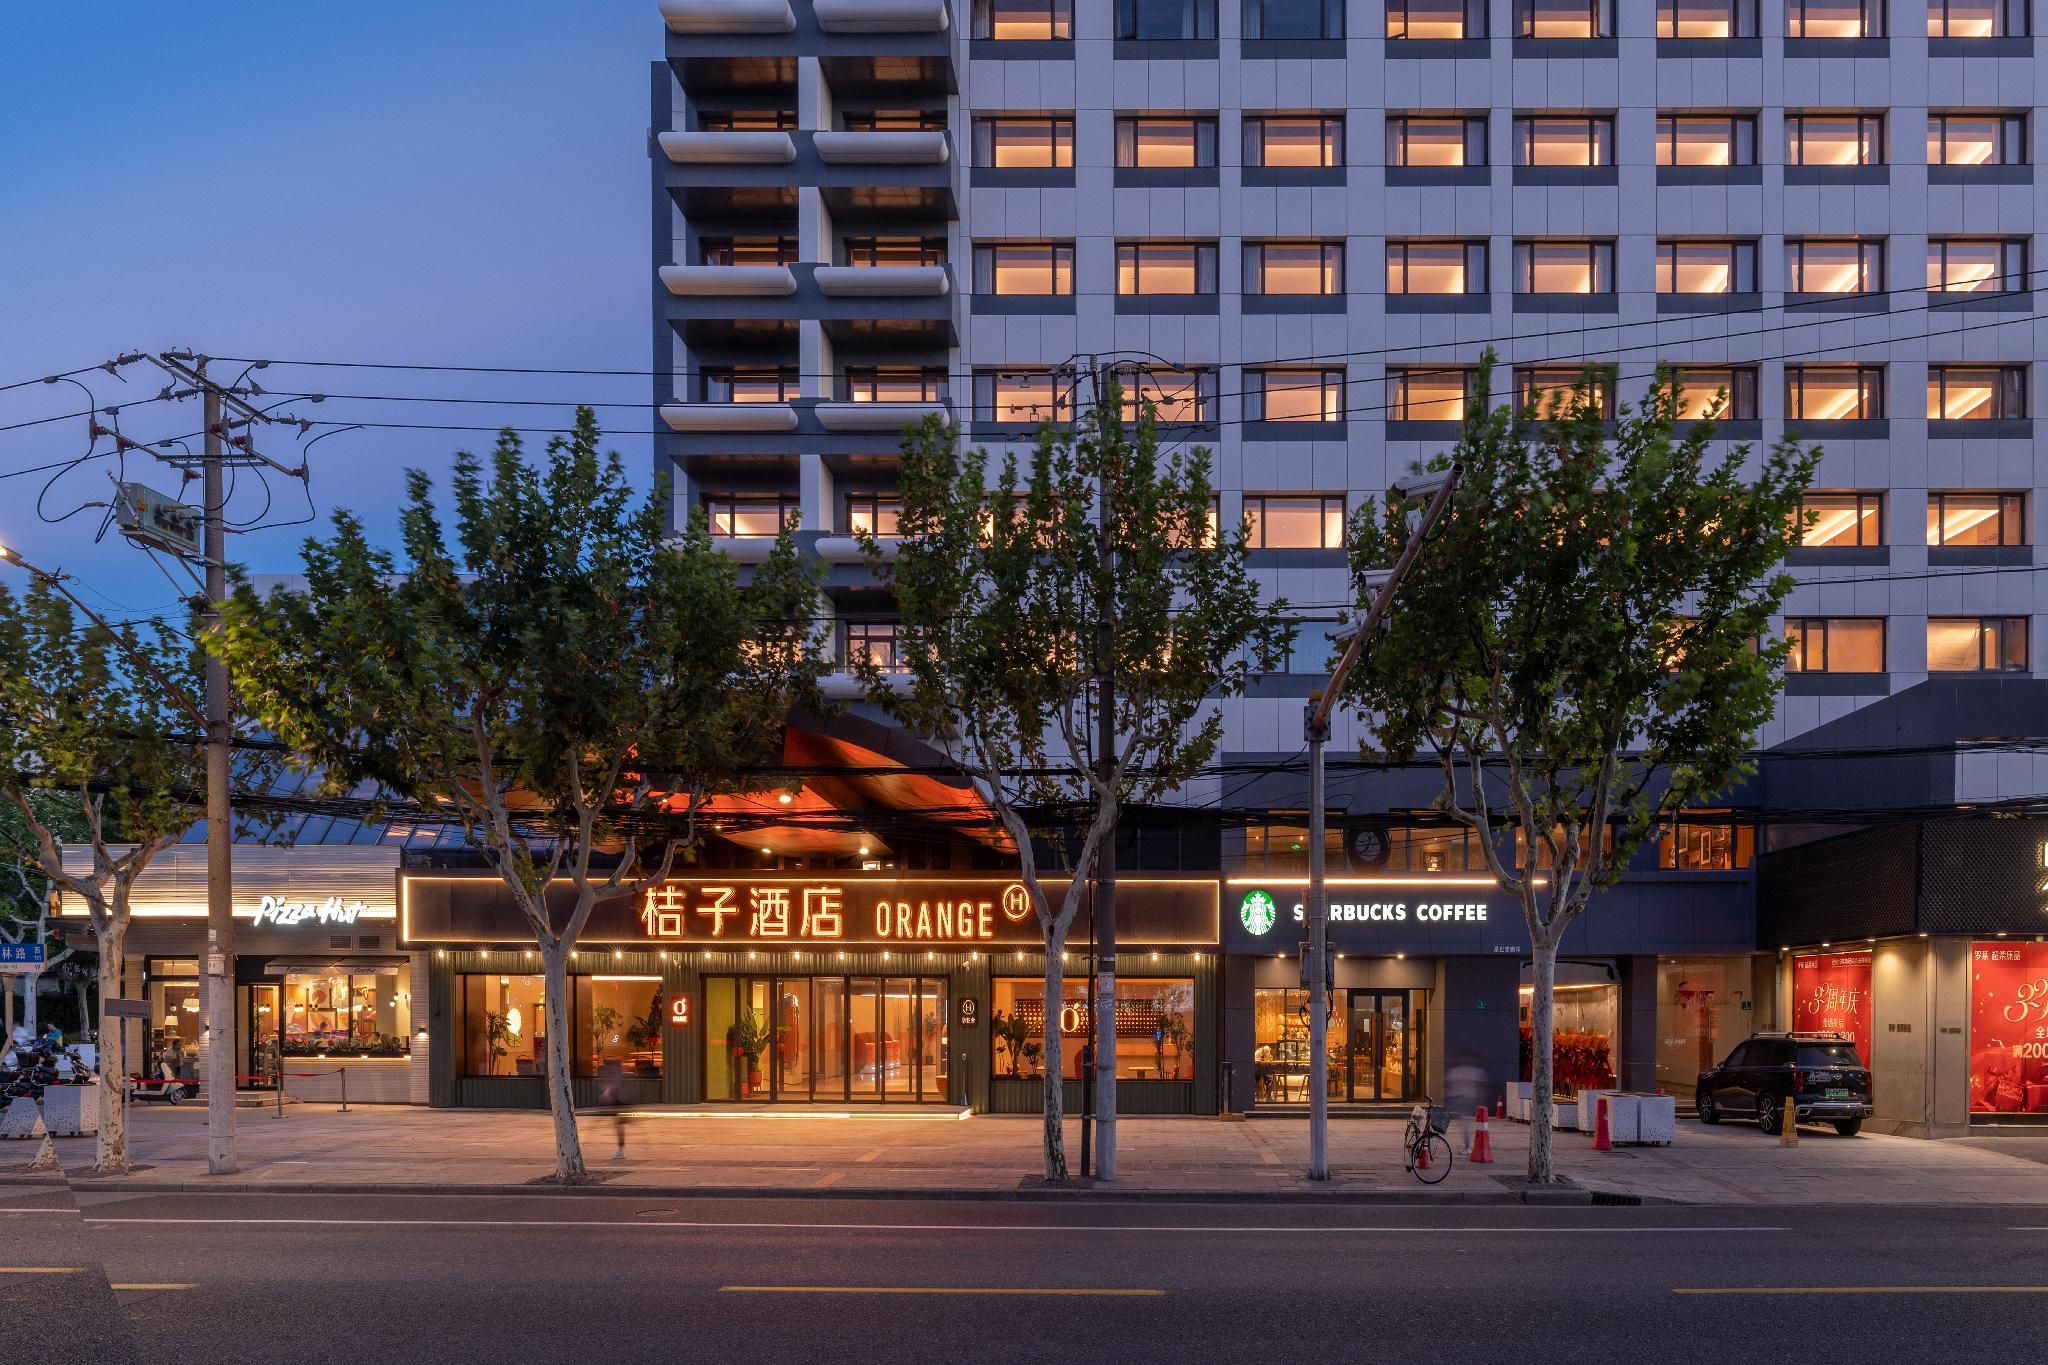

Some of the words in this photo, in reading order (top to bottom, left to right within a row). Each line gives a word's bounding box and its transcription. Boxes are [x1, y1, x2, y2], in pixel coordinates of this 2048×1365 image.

[253, 895, 318, 926] Pizza
[319, 896, 364, 924] Hut
[642, 885, 843, 937] 桔子酒店
[876, 901, 993, 938] ORANGE
[1293, 904, 1406, 921] SRBUCKS
[1417, 904, 1487, 921] COFFEE
